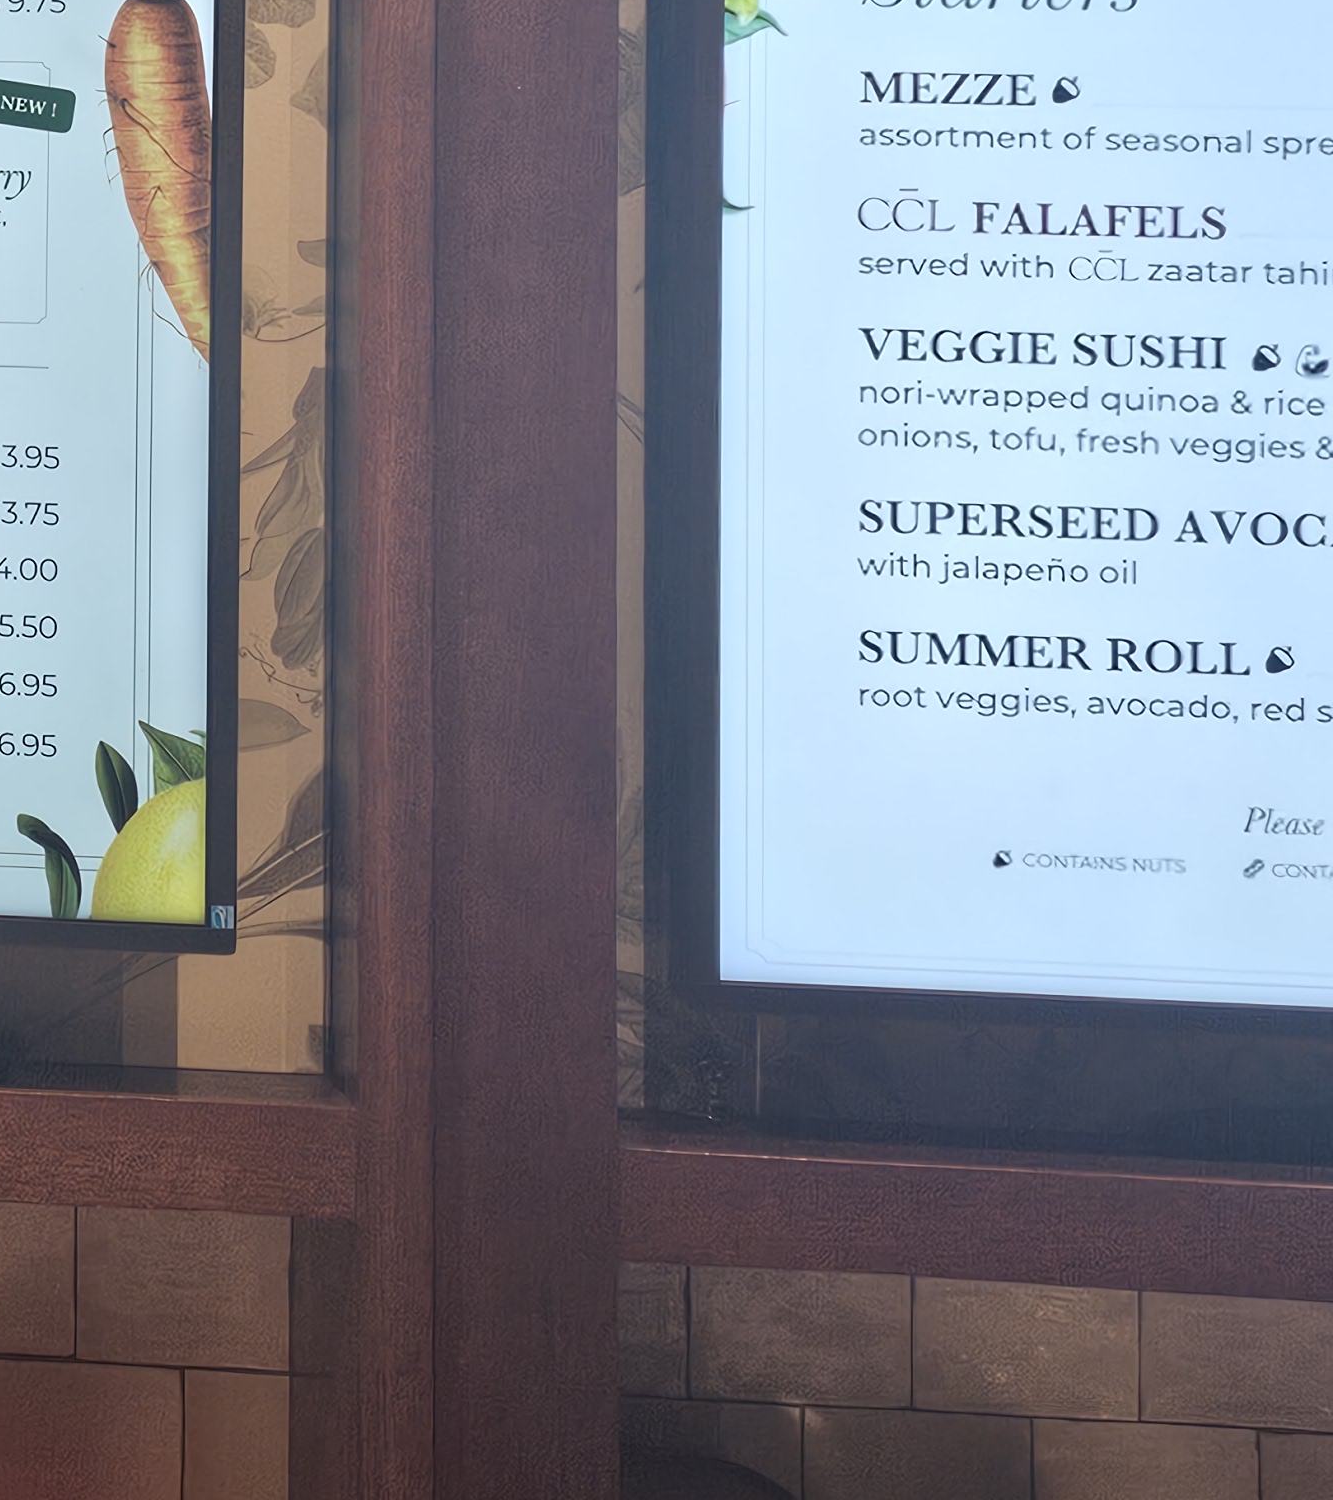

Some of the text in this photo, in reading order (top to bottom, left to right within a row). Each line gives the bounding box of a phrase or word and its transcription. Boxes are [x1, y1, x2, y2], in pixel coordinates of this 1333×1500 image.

[0, 94, 46, 115] NEW
[859, 69, 1037, 107] MEZZE
[859, 124, 1252, 154] assortment of seasonal
[971, 200, 1227, 241] FALAFELS
[858, 251, 1054, 279] served with
[1147, 260, 1253, 284] zaatar
[858, 326, 1227, 370] VEGGIE SUSHI
[859, 378, 1326, 417] nori-wrapped quinoa & rice
[857, 421, 979, 454] onions,
[988, 425, 1066, 457] tofu,
[1076, 426, 1159, 455] fresh
[1169, 431, 1306, 464] veggies
[859, 498, 1160, 542] SUPERSEED
[857, 550, 1137, 587] with jalapeño oil
[858, 628, 1251, 676] SUMMER ROLL
[859, 685, 1305, 724] root veggies, avocado, red
[1243, 805, 1325, 836] Please
[1022, 851, 1187, 874] CONTAINS NUTS
